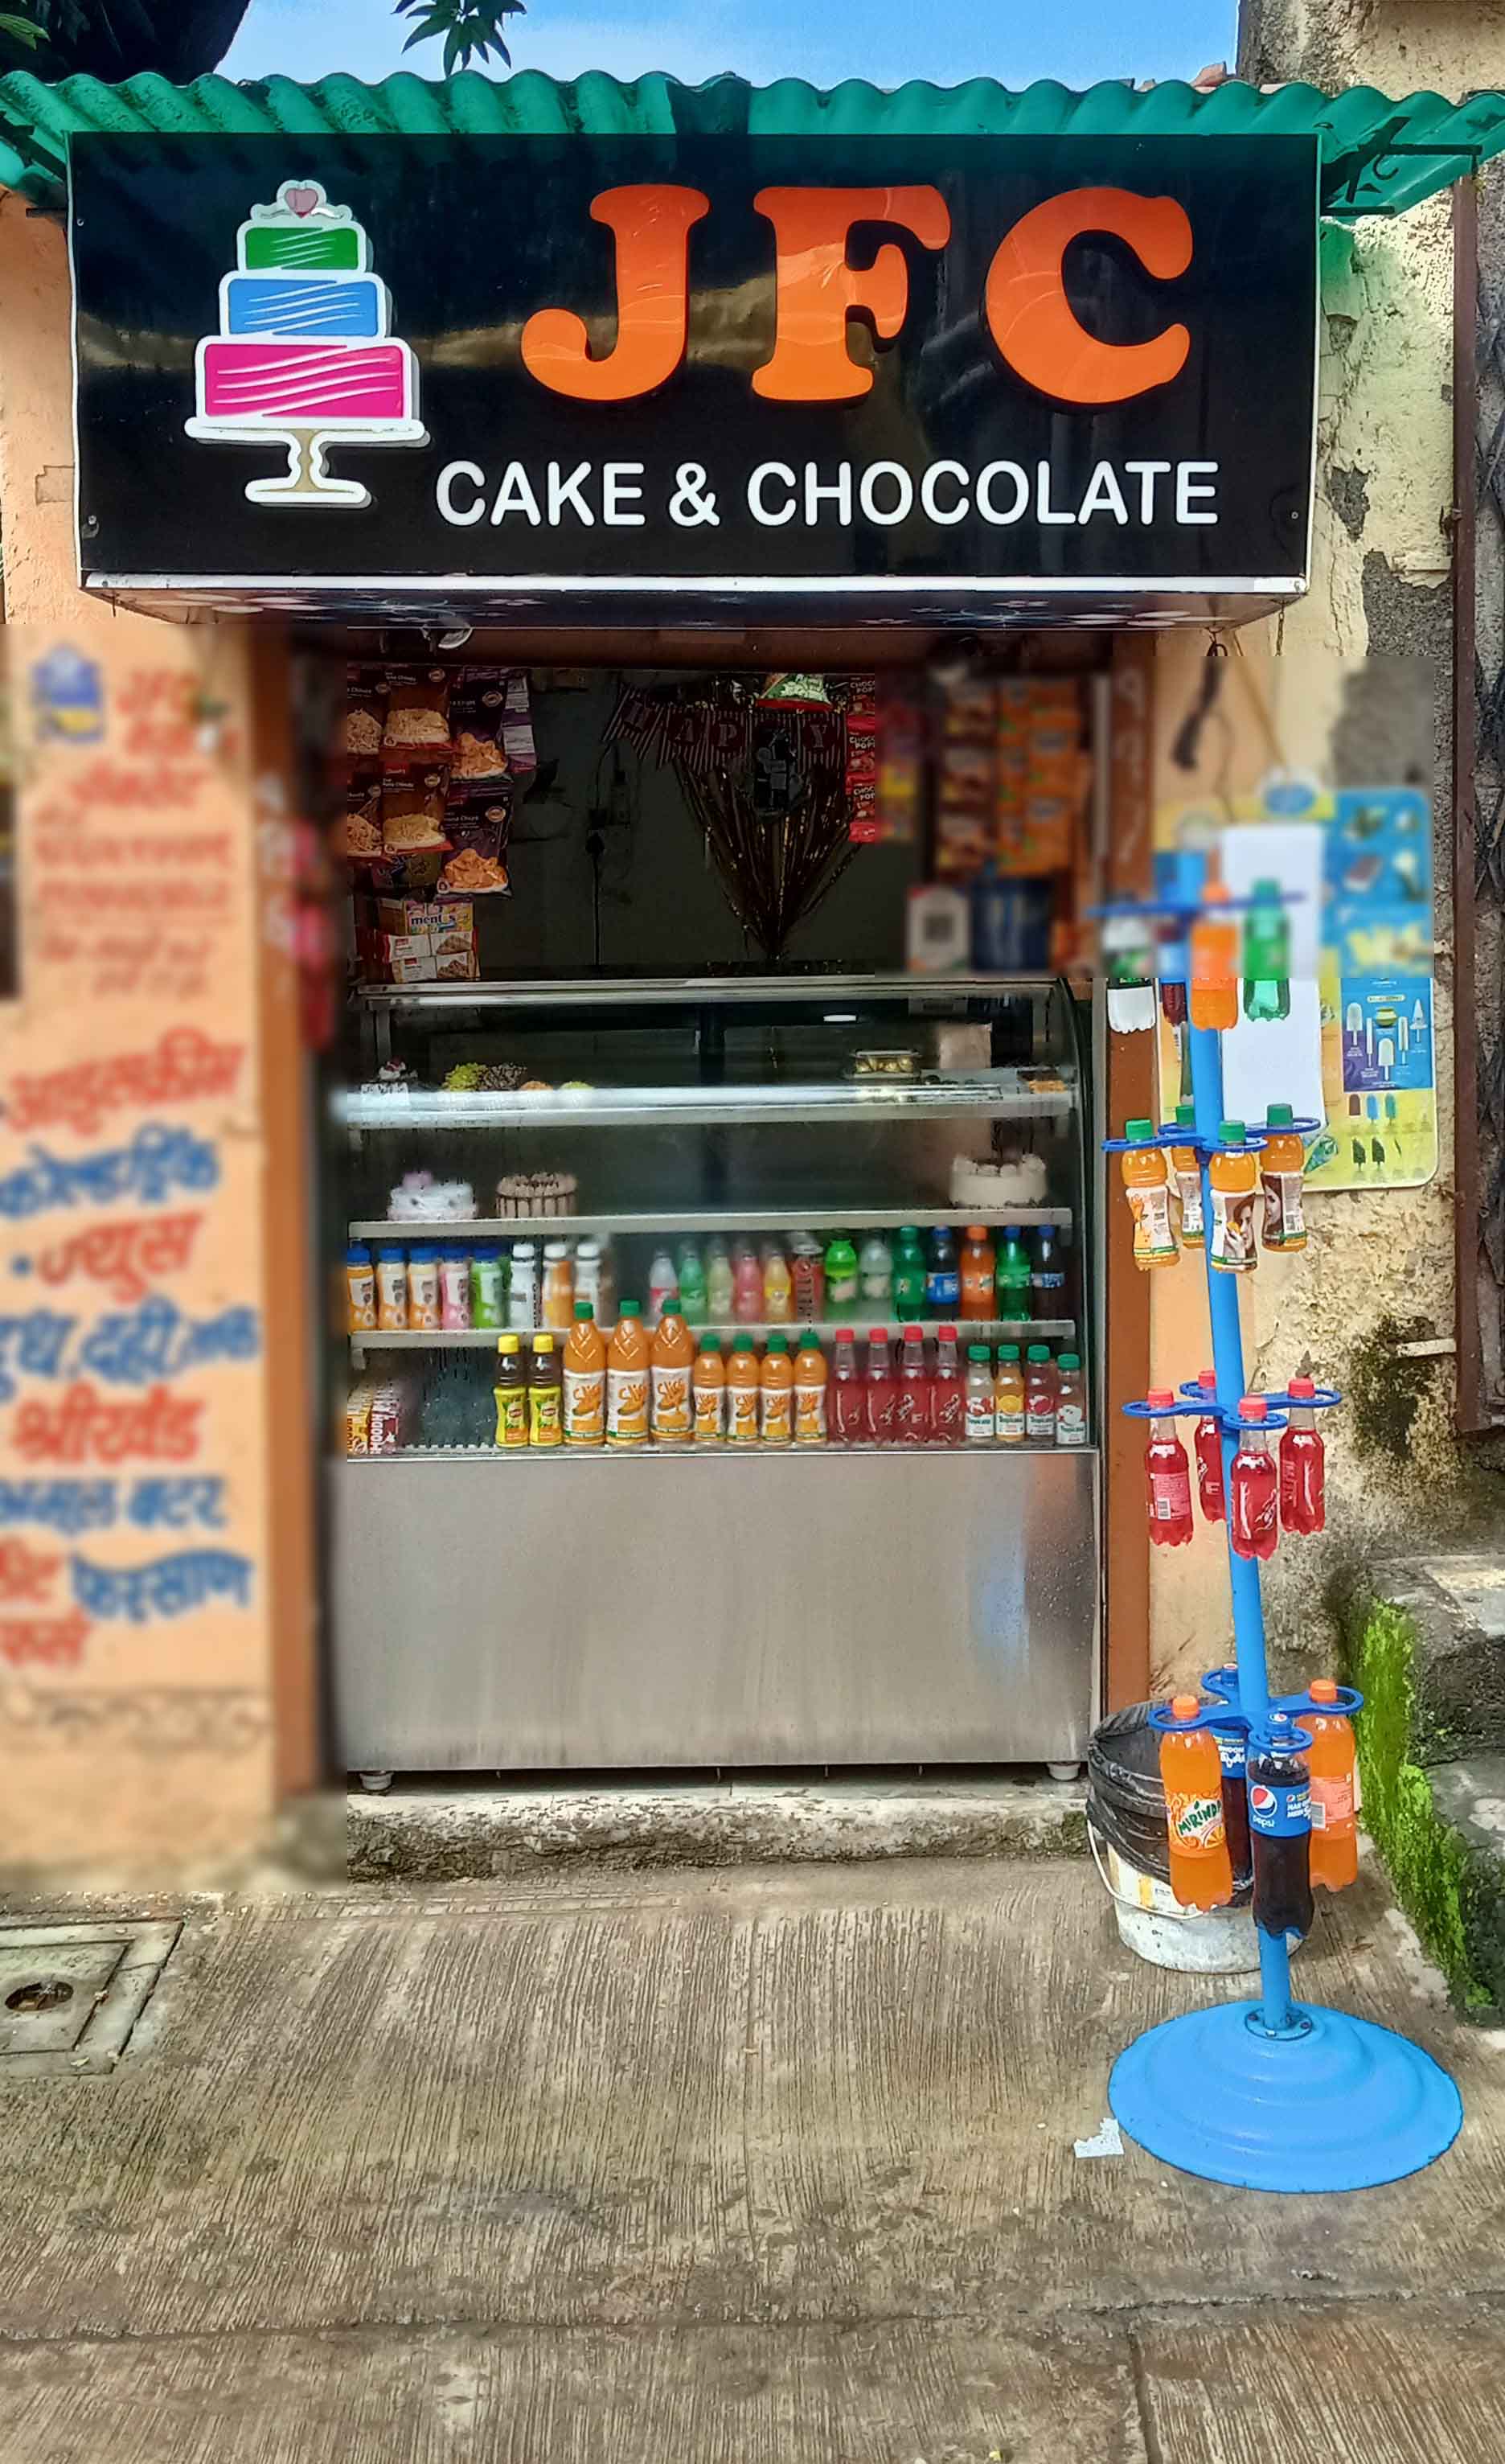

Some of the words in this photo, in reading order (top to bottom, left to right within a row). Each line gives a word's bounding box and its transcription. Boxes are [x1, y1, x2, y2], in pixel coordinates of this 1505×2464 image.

[521, 183, 1193, 404] JFC
[437, 460, 645, 527] CAKE
[669, 462, 720, 527] &
[747, 461, 1218, 526] CHOCOLATE
